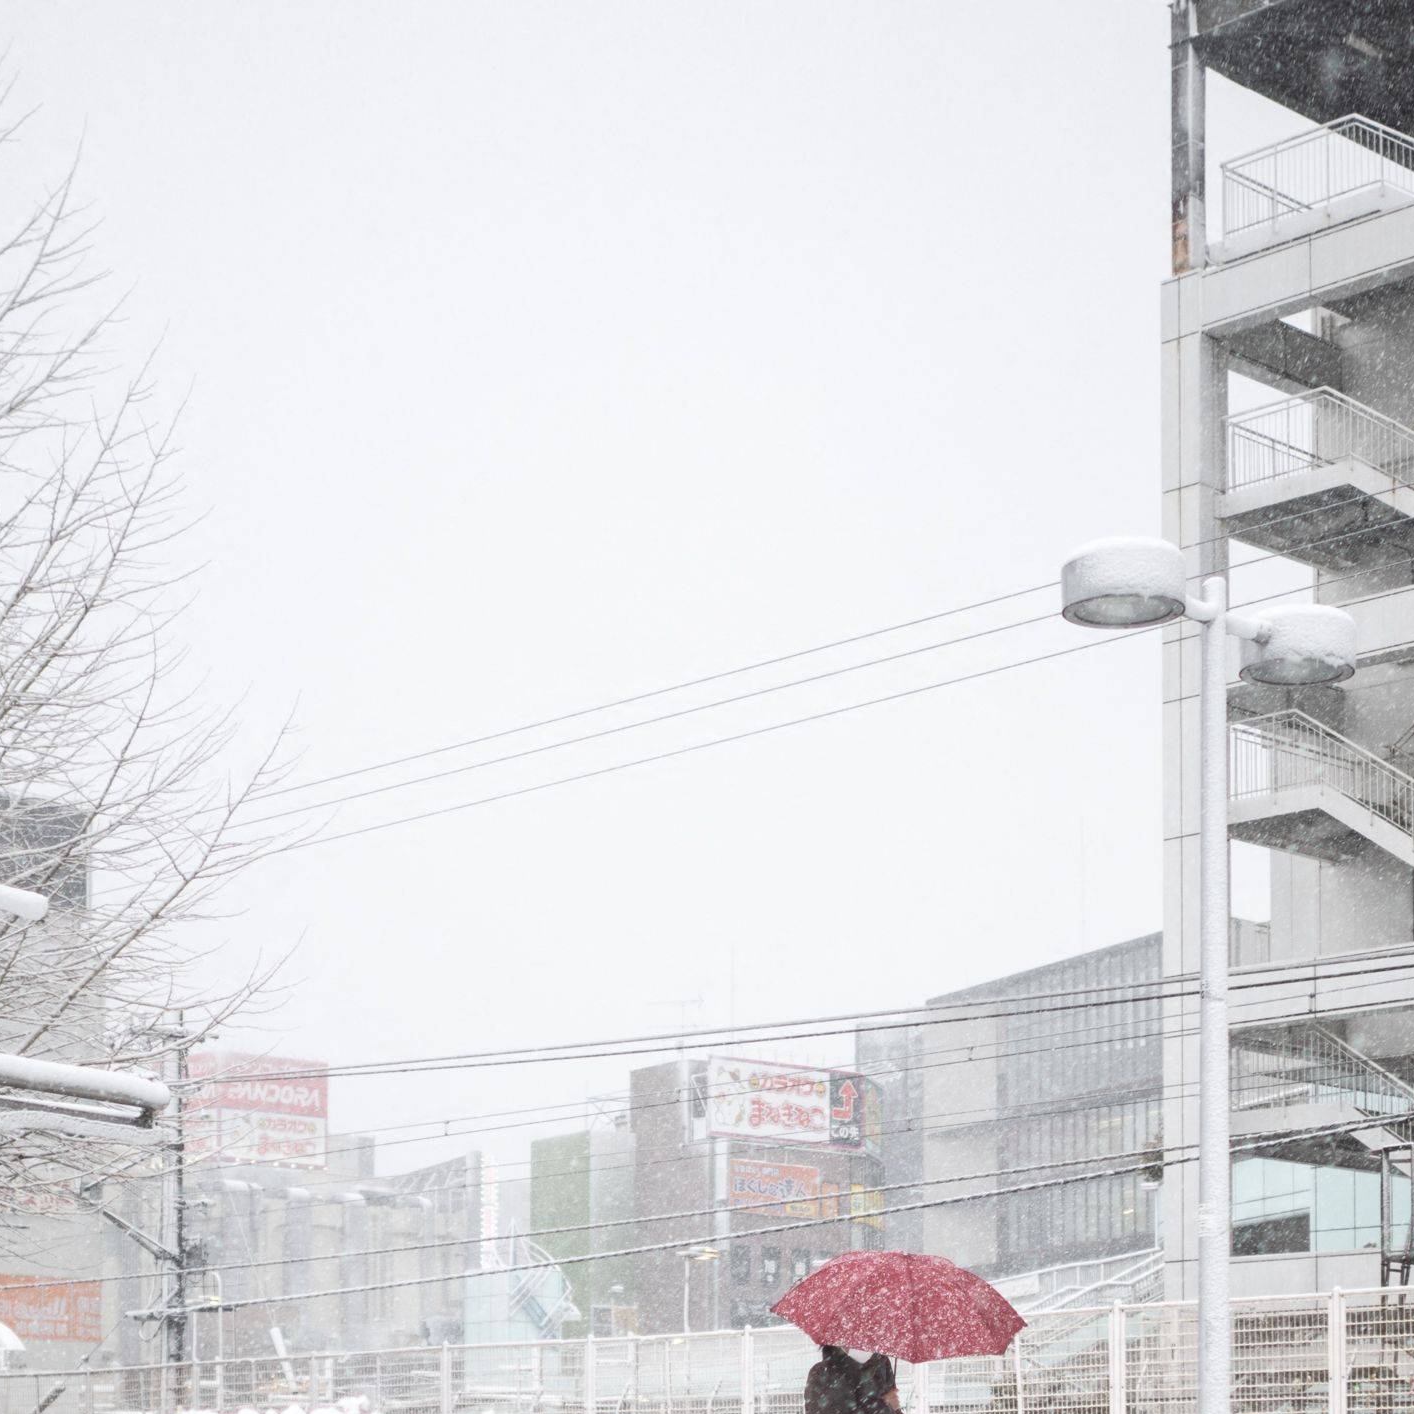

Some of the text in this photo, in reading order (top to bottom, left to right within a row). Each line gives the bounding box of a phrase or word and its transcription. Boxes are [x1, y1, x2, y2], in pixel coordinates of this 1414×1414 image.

[749, 1098, 825, 1129] まねきねこ
